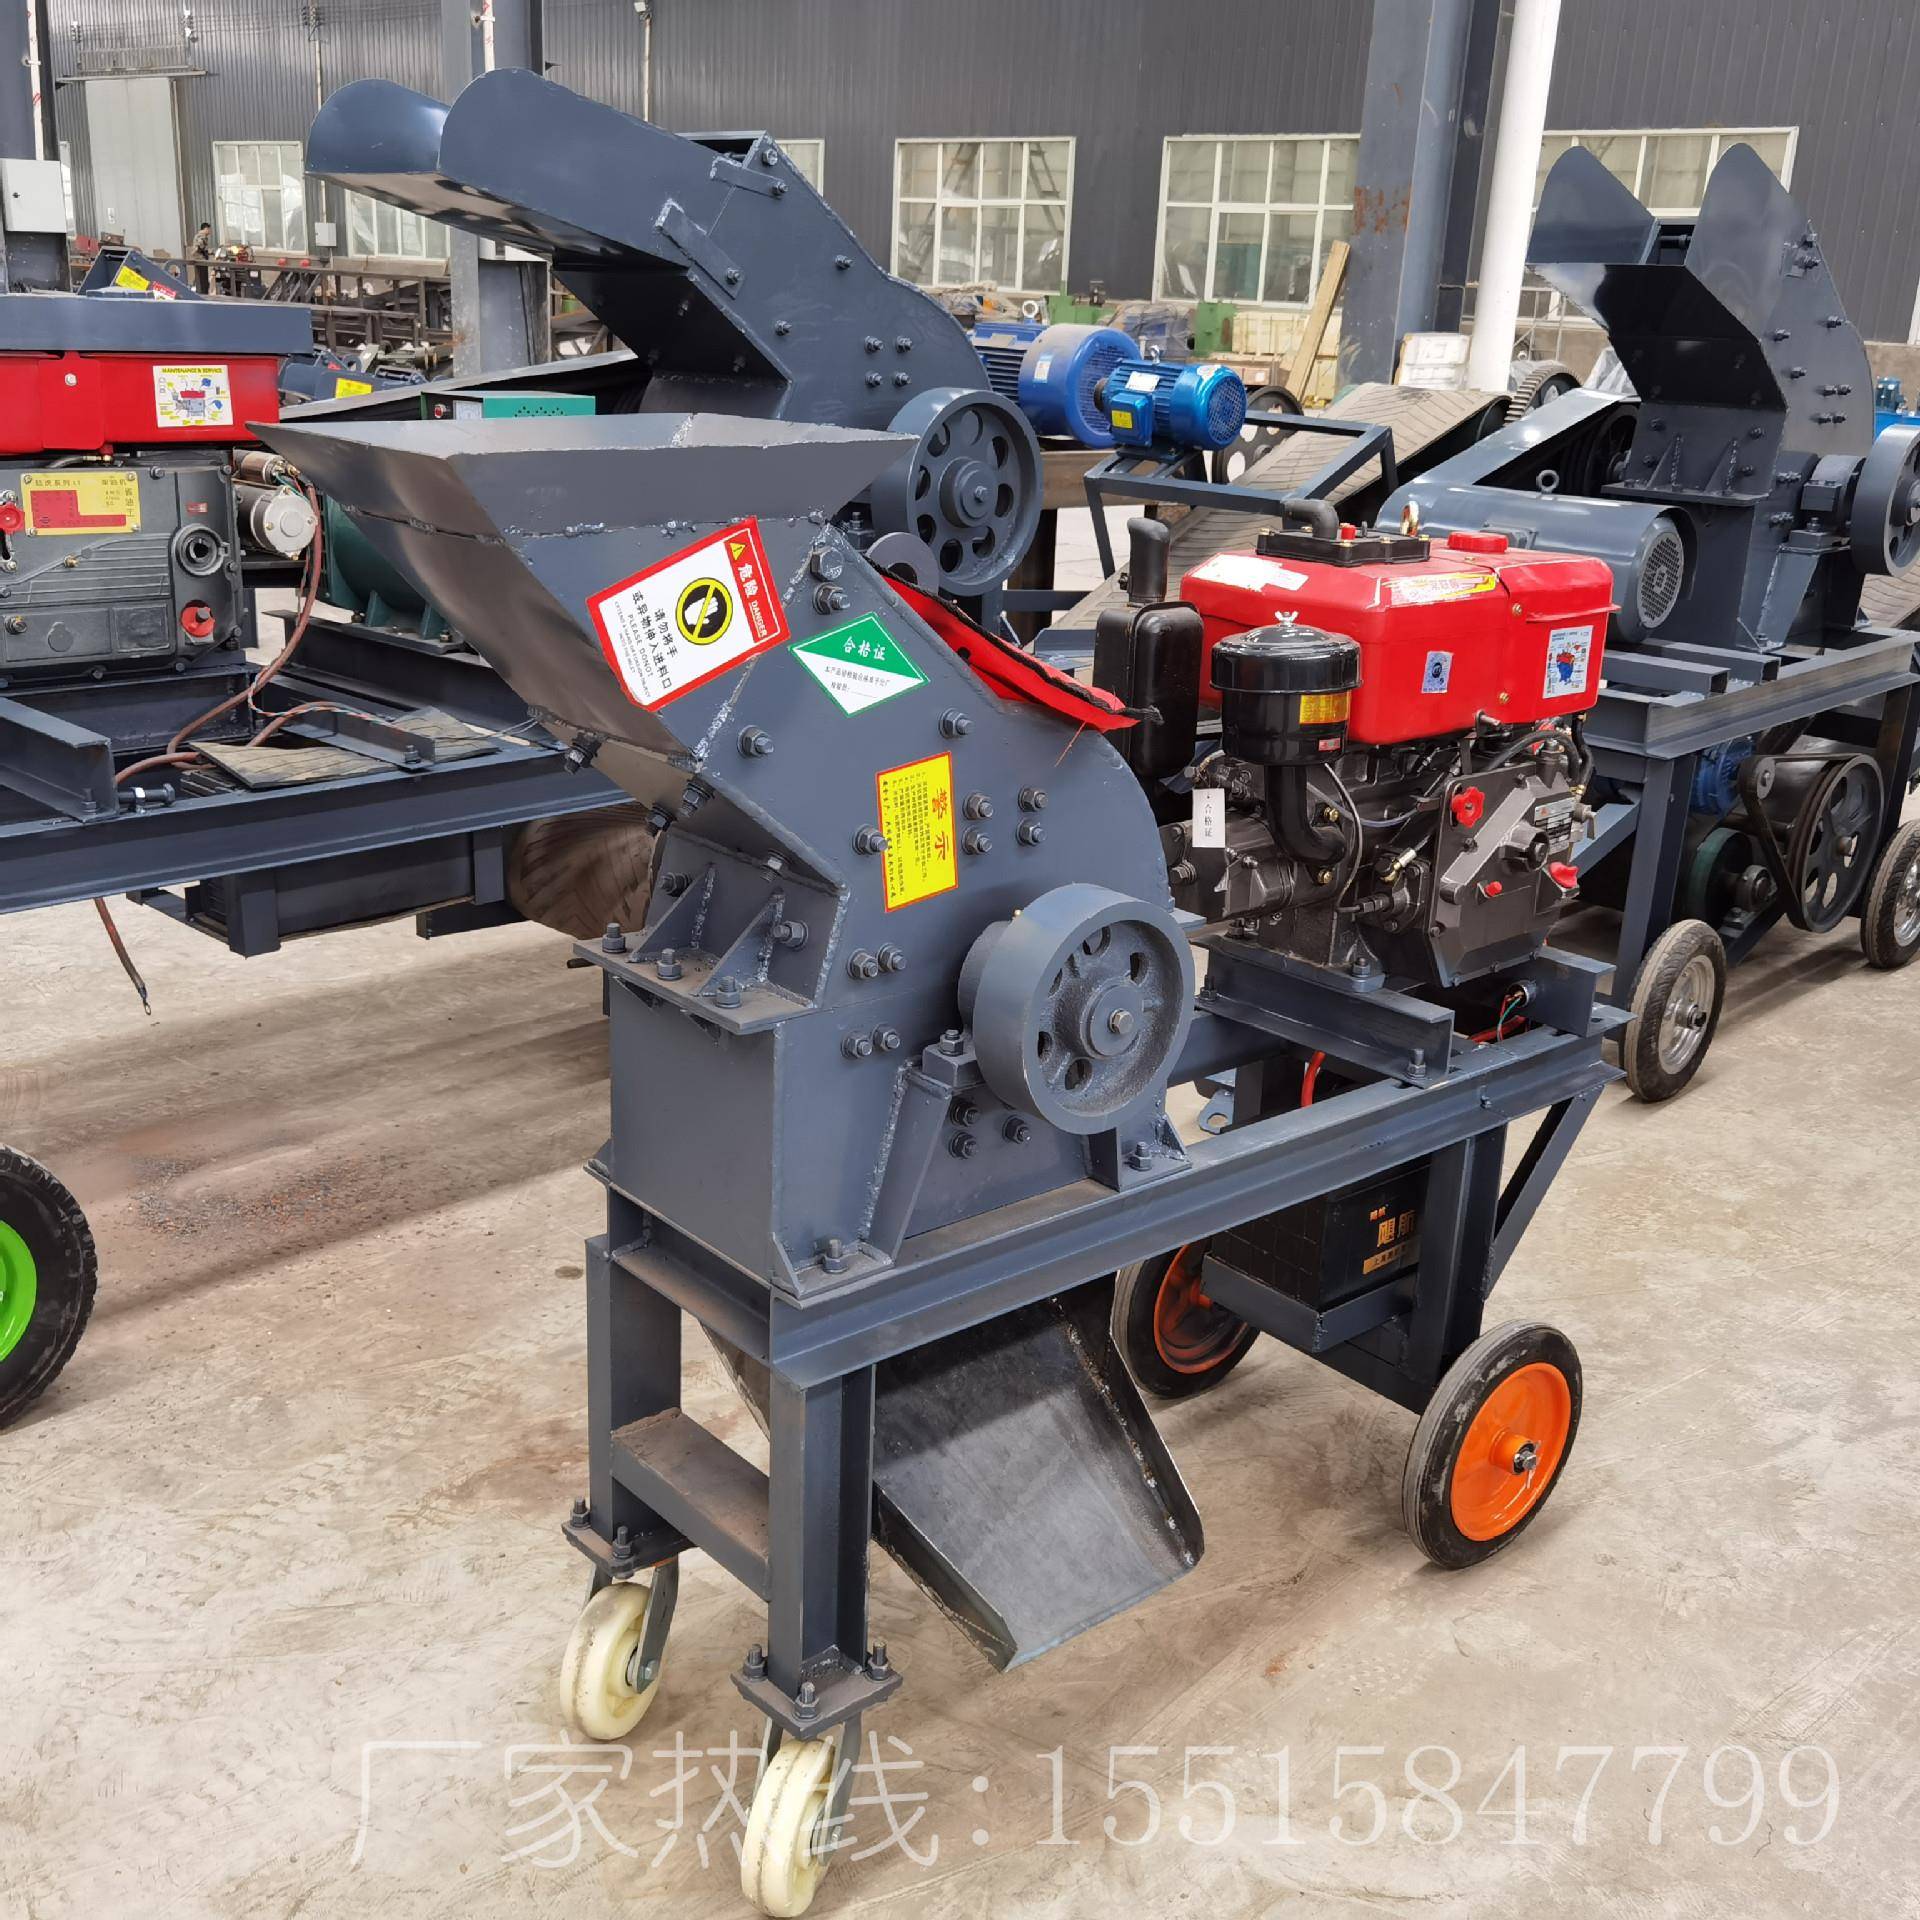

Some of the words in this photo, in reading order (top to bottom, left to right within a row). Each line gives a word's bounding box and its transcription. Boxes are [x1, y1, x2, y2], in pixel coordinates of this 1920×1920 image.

[738, 563, 759, 598] 危险
[628, 614, 643, 647] PLEASE
[654, 608, 678, 658] 请勿将手
[751, 600, 768, 638] DANGER
[632, 591, 672, 689] 或异物伸入进料口
[843, 635, 886, 661] 合格证
[931, 787, 950, 861] 警示
[1204, 803, 1214, 838] 合格证
